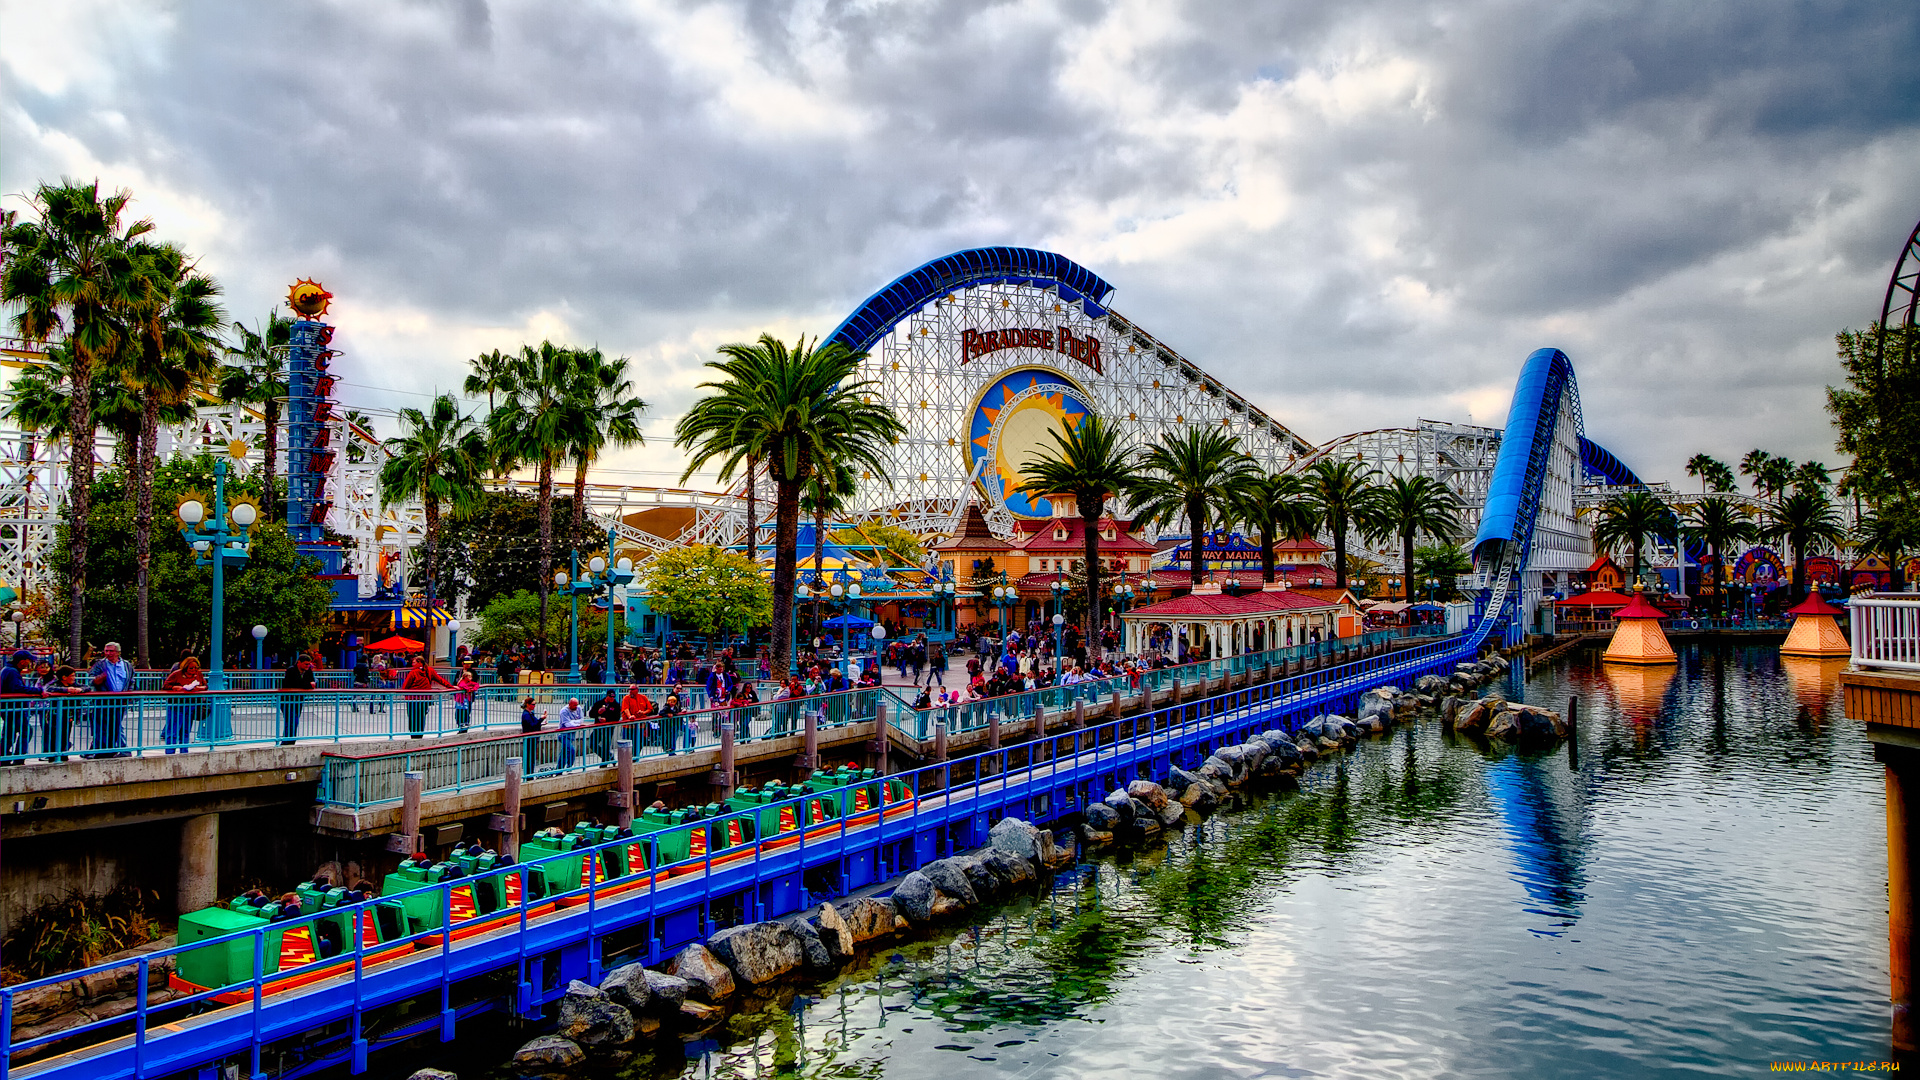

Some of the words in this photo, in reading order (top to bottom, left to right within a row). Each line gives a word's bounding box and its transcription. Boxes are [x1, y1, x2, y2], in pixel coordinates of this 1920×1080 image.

[961, 327, 1055, 366] PARADISE
[1057, 326, 1104, 376] PIER
[1179, 551, 1223, 560] MIWAY
[403, 598, 428, 607] SCREA
